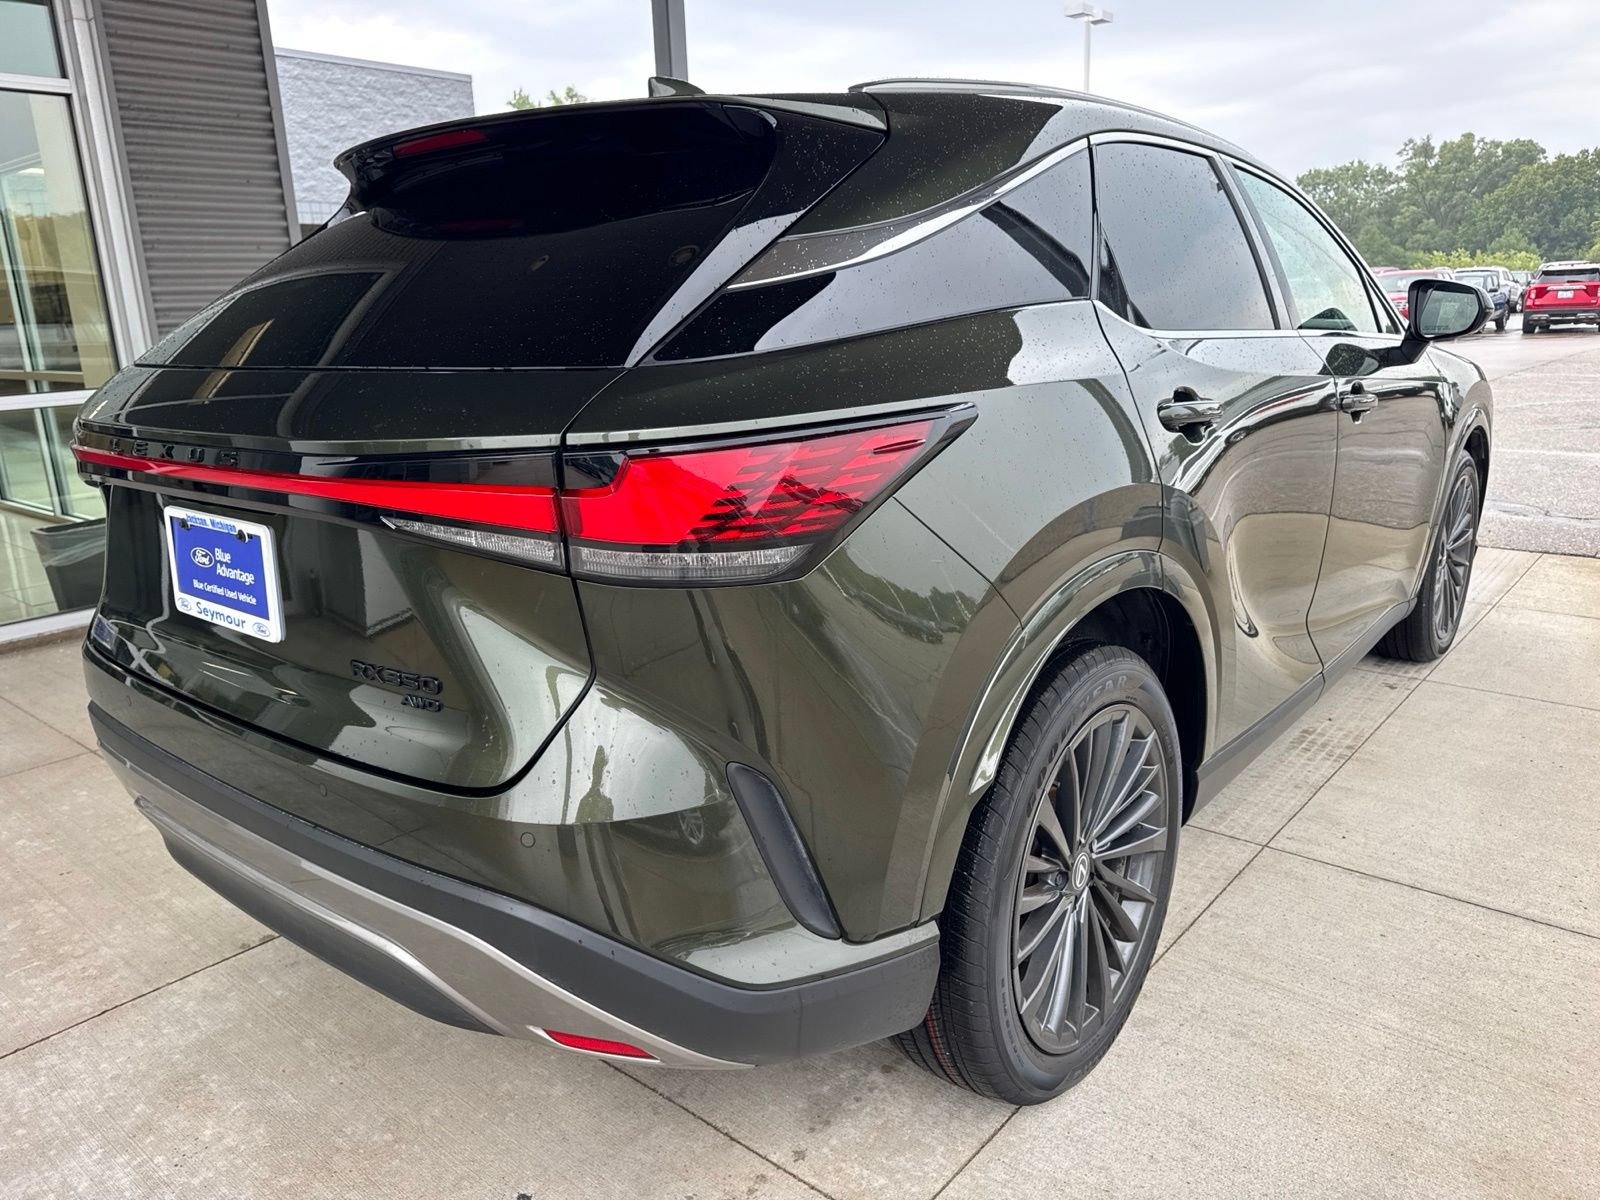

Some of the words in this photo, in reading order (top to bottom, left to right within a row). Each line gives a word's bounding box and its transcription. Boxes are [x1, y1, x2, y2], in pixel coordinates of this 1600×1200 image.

[111, 438, 239, 468] LEXUS
[210, 518, 237, 533] Michigan
[194, 549, 210, 565] Ford
[214, 547, 231, 563] Blue
[216, 563, 255, 585] Advantage
[192, 579, 204, 590] Blue
[204, 582, 225, 596] Certified
[225, 588, 238, 599] Used
[238, 592, 257, 605] Vehicle
[196, 601, 246, 629] Seymour
[350, 659, 443, 695] RX350
[401, 694, 444, 712] AWD
